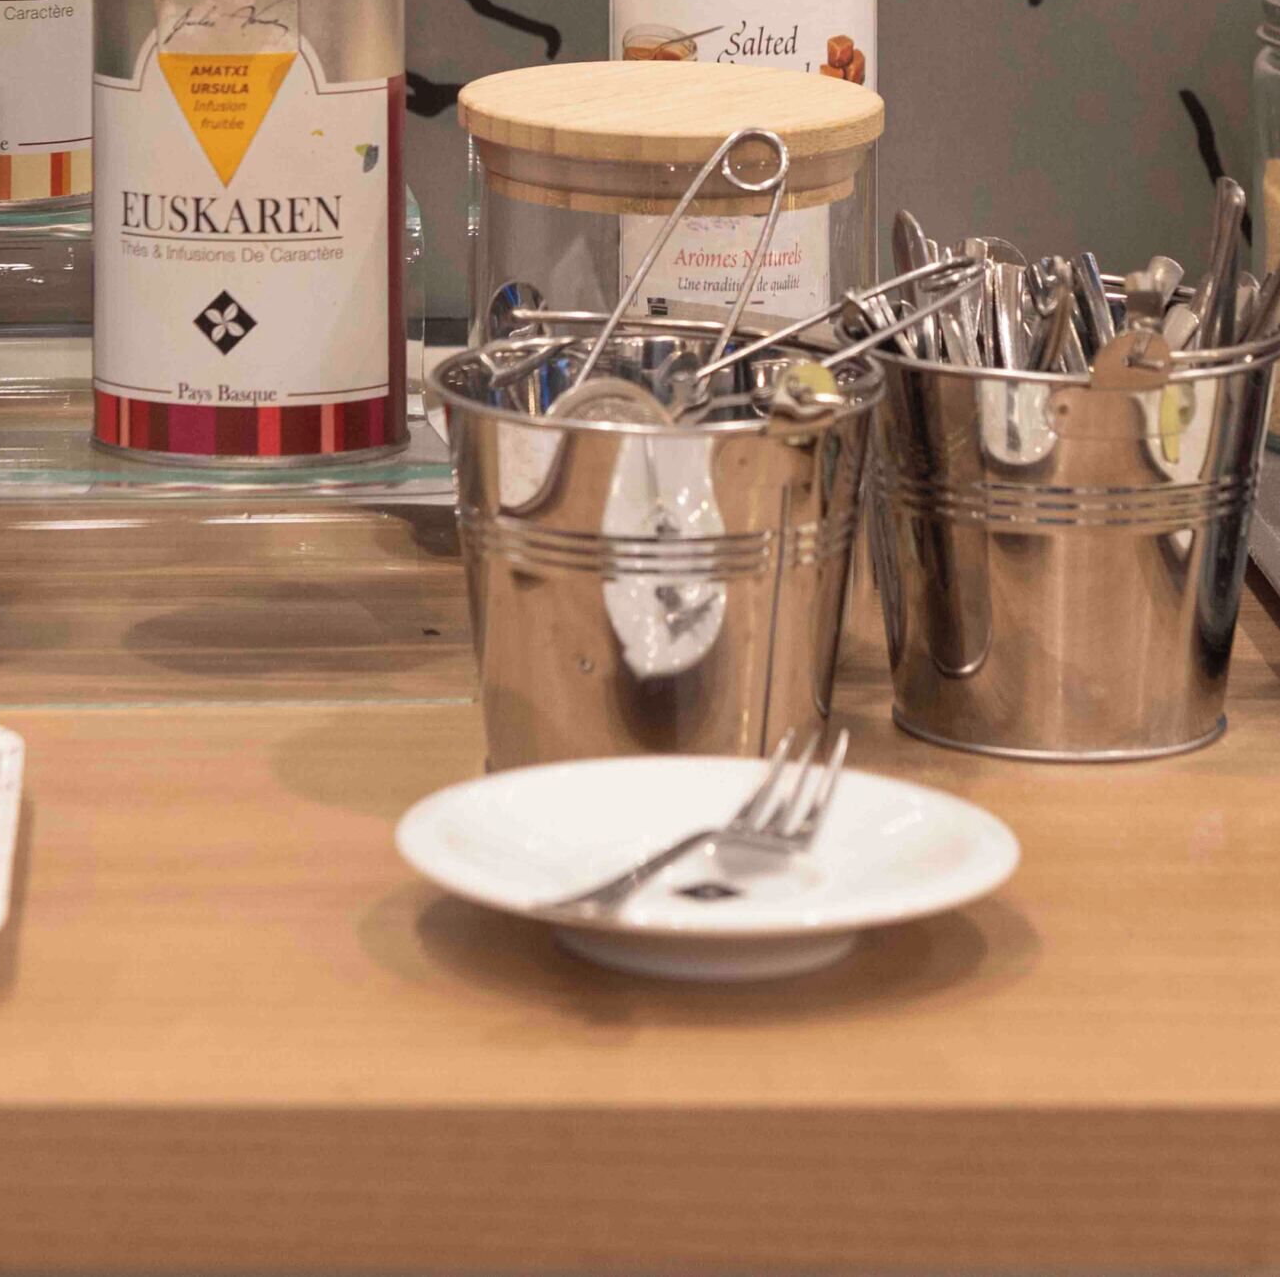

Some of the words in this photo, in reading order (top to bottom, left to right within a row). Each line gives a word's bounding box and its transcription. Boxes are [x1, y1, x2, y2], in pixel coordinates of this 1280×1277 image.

[5, 5, 73, 21] Caractère
[724, 21, 798, 56] Salted
[190, 65, 249, 77] AMATXI
[190, 83, 250, 94] URSULA
[193, 100, 247, 112] Infusion
[200, 118, 244, 131] fruitée
[121, 190, 342, 234] EUSKAREN
[153, 245, 162, 259] &
[167, 245, 235, 262] Infusions
[241, 248, 265, 263] De
[270, 247, 343, 263] Caractère
[675, 245, 737, 267] Arômes
[678, 277, 700, 291] Une
[703, 277, 744, 291] traditi
[757, 276, 767, 291] de
[770, 274, 800, 296] qualité
[178, 382, 212, 405] Pays
[218, 384, 278, 406] Basque
